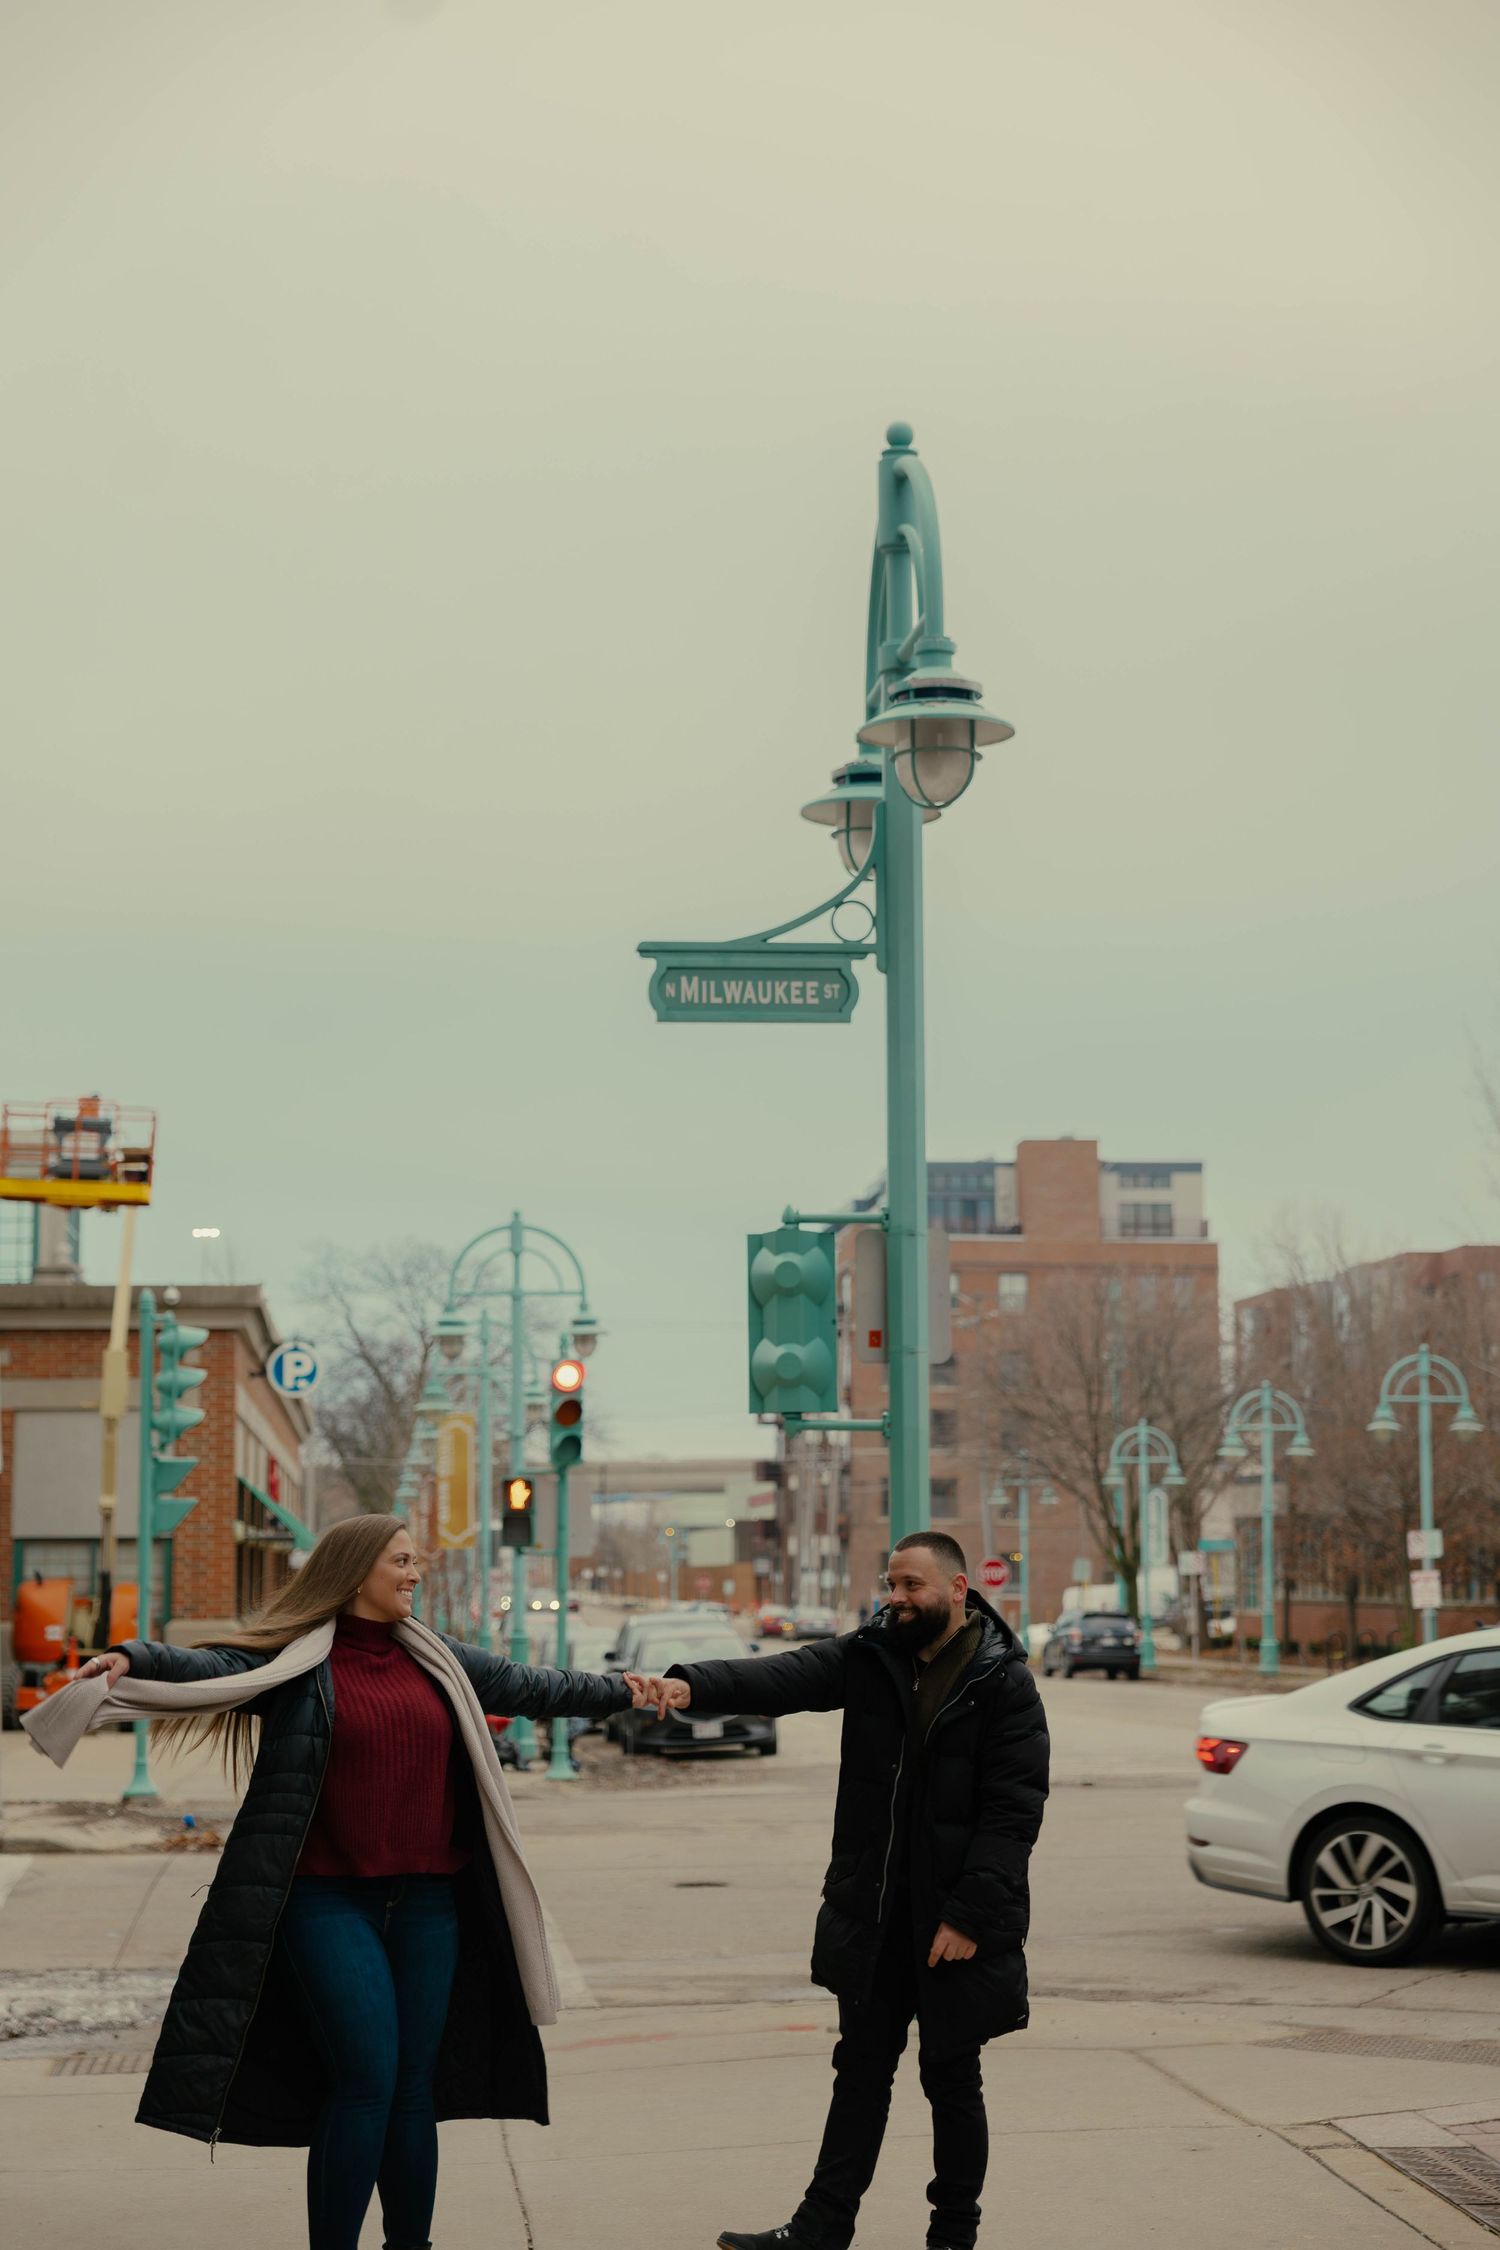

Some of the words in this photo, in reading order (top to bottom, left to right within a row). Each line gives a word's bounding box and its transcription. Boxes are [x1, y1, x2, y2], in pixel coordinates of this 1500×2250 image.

[666, 982, 675, 998] N
[680, 975, 819, 1004] MILWAUKEE
[824, 984, 840, 999] ST
